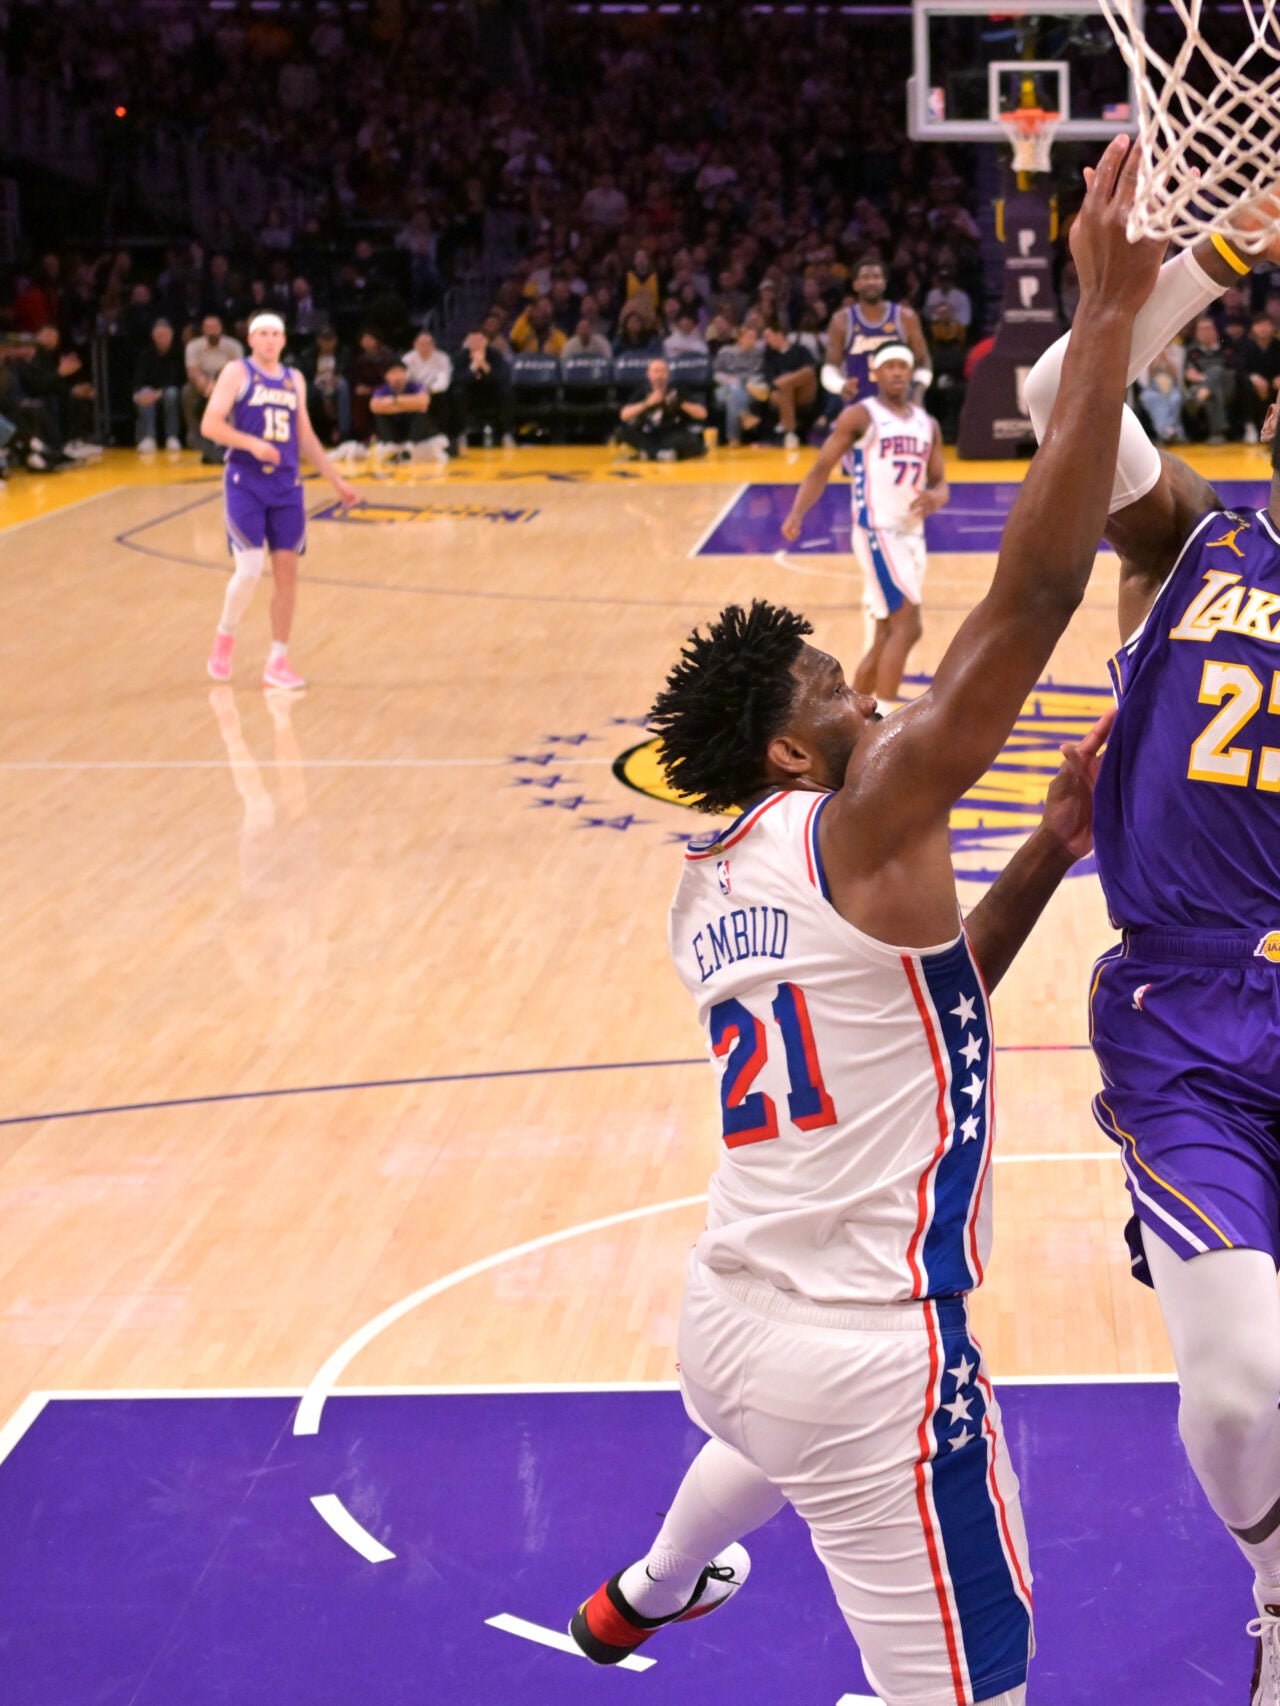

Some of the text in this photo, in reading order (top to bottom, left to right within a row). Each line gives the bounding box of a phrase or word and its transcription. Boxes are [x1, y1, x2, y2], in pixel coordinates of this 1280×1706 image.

[263, 407, 290, 442] 15
[892, 461, 922, 486] 77
[693, 906, 788, 983] EMBIID
[710, 982, 838, 1149] 21
